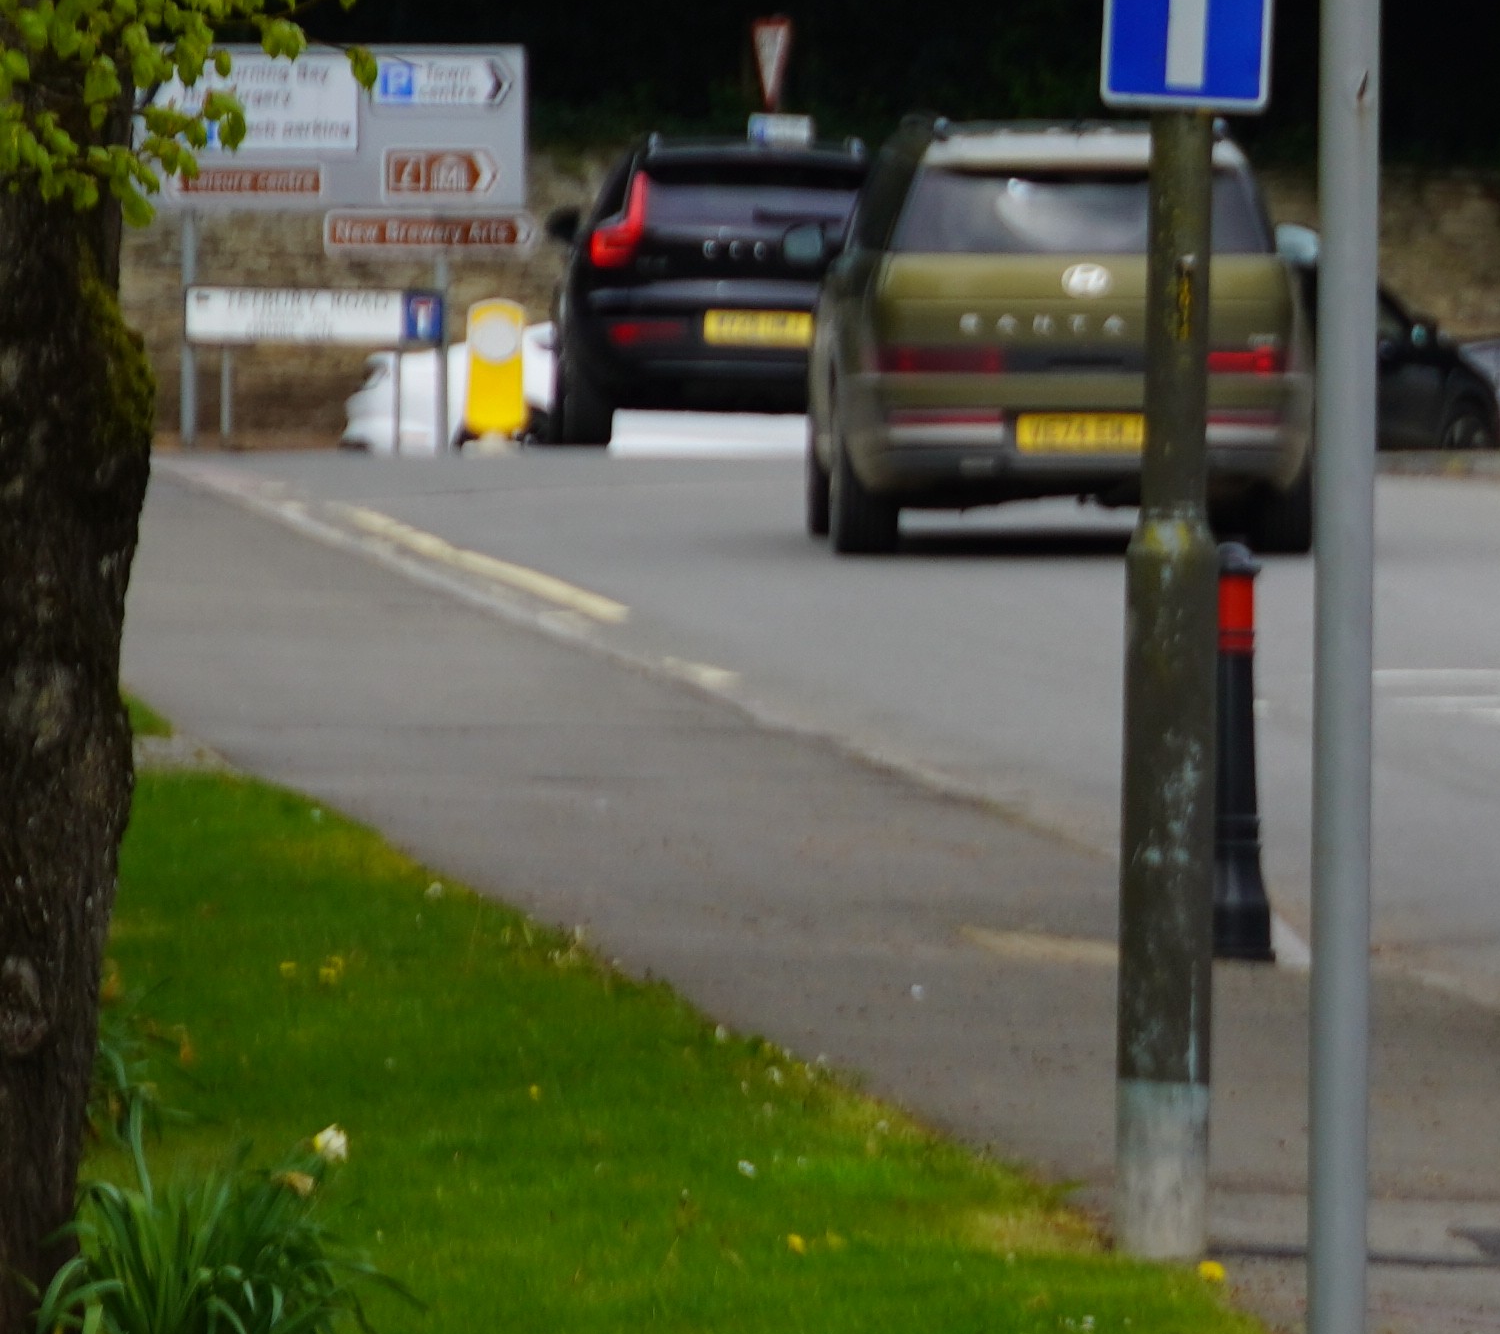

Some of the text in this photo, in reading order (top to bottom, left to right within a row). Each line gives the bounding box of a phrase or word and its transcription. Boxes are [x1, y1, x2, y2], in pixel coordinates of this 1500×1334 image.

[334, 219, 511, 246] New Brewery Arts
